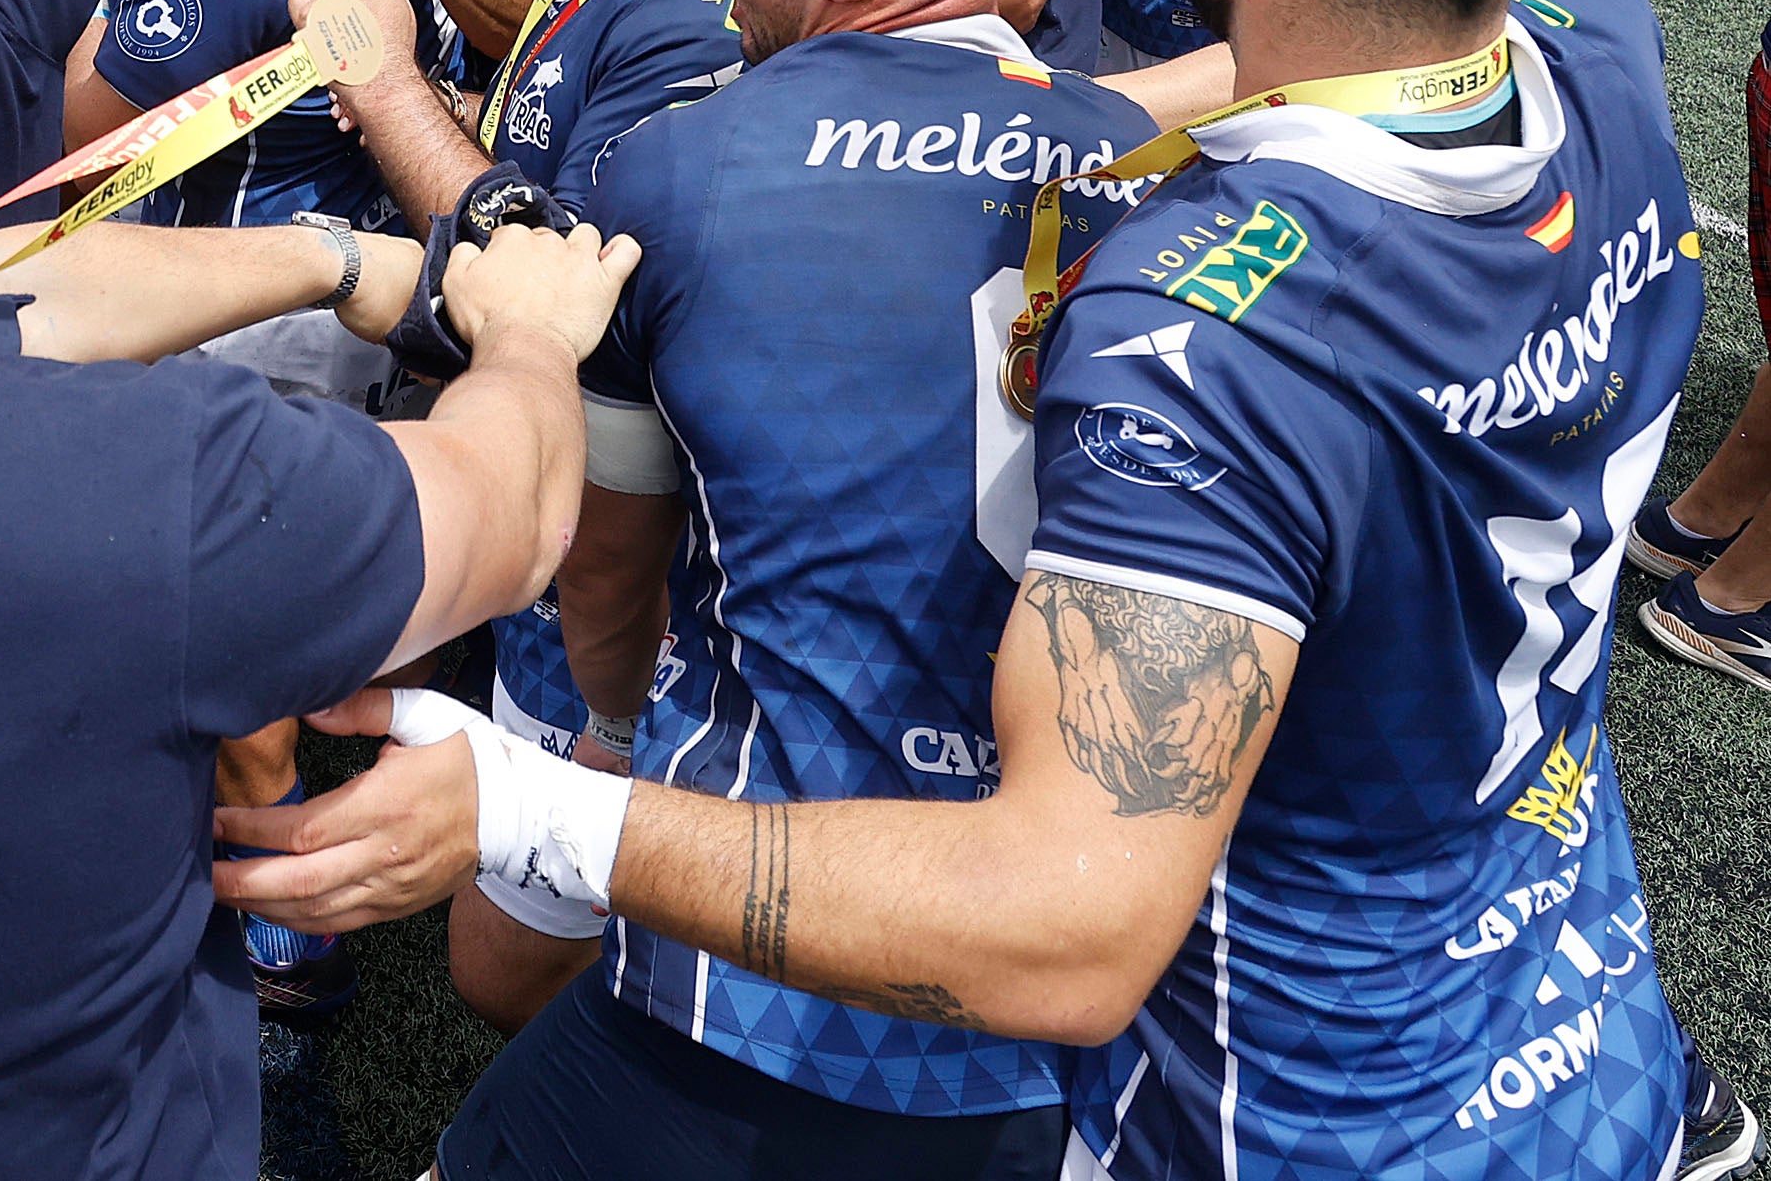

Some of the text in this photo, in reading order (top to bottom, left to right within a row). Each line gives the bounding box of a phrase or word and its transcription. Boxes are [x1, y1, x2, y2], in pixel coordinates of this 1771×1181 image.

[119, 21, 160, 57] DESDE 1994
[247, 50, 314, 104] FERugby
[1399, 65, 1489, 103] FERugby
[73, 157, 156, 222] FERugby
[982, 199, 1090, 232] PATAS
[1139, 212, 1237, 283] PIVOT
[1551, 369, 1626, 446] PATATAS
[1099, 445, 1153, 476] ESDE
